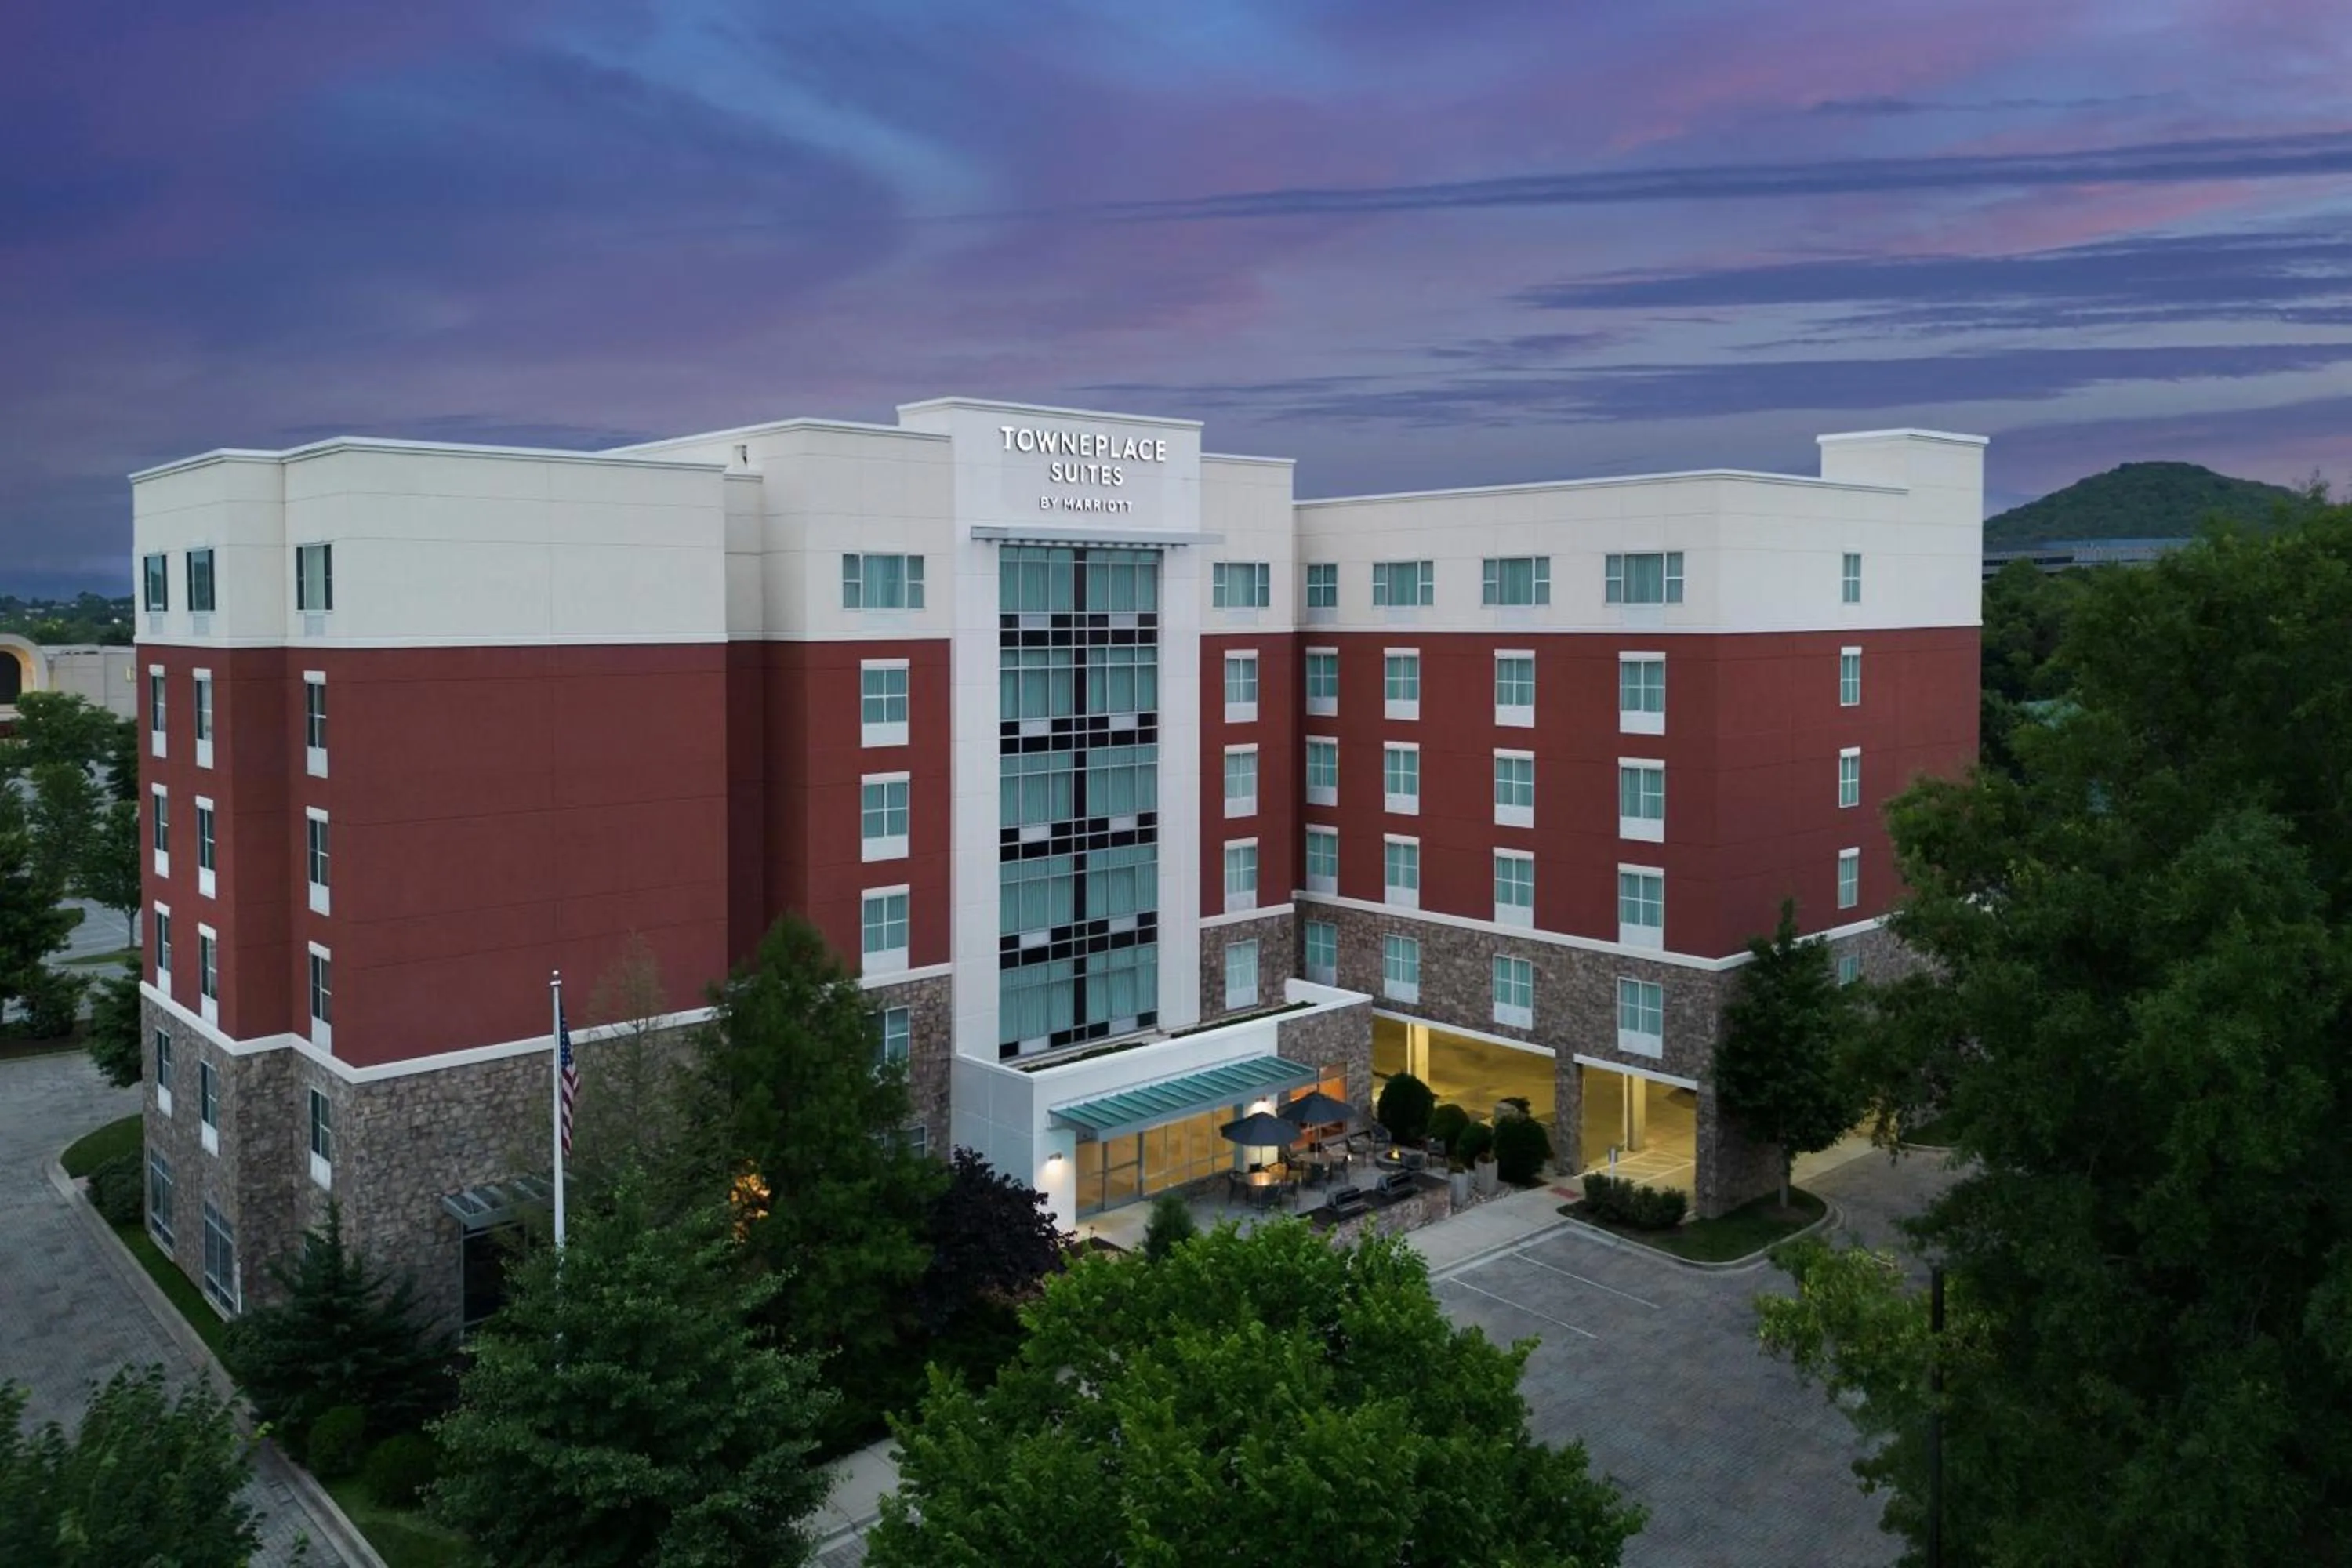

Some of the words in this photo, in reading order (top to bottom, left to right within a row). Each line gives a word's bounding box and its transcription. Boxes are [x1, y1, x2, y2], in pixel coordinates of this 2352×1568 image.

[1000, 426, 1167, 461] TOWNEPLACE
[1051, 462, 1123, 485] SUITES
[1040, 495, 1057, 510] BY
[1063, 497, 1132, 513] MARRIOTT
